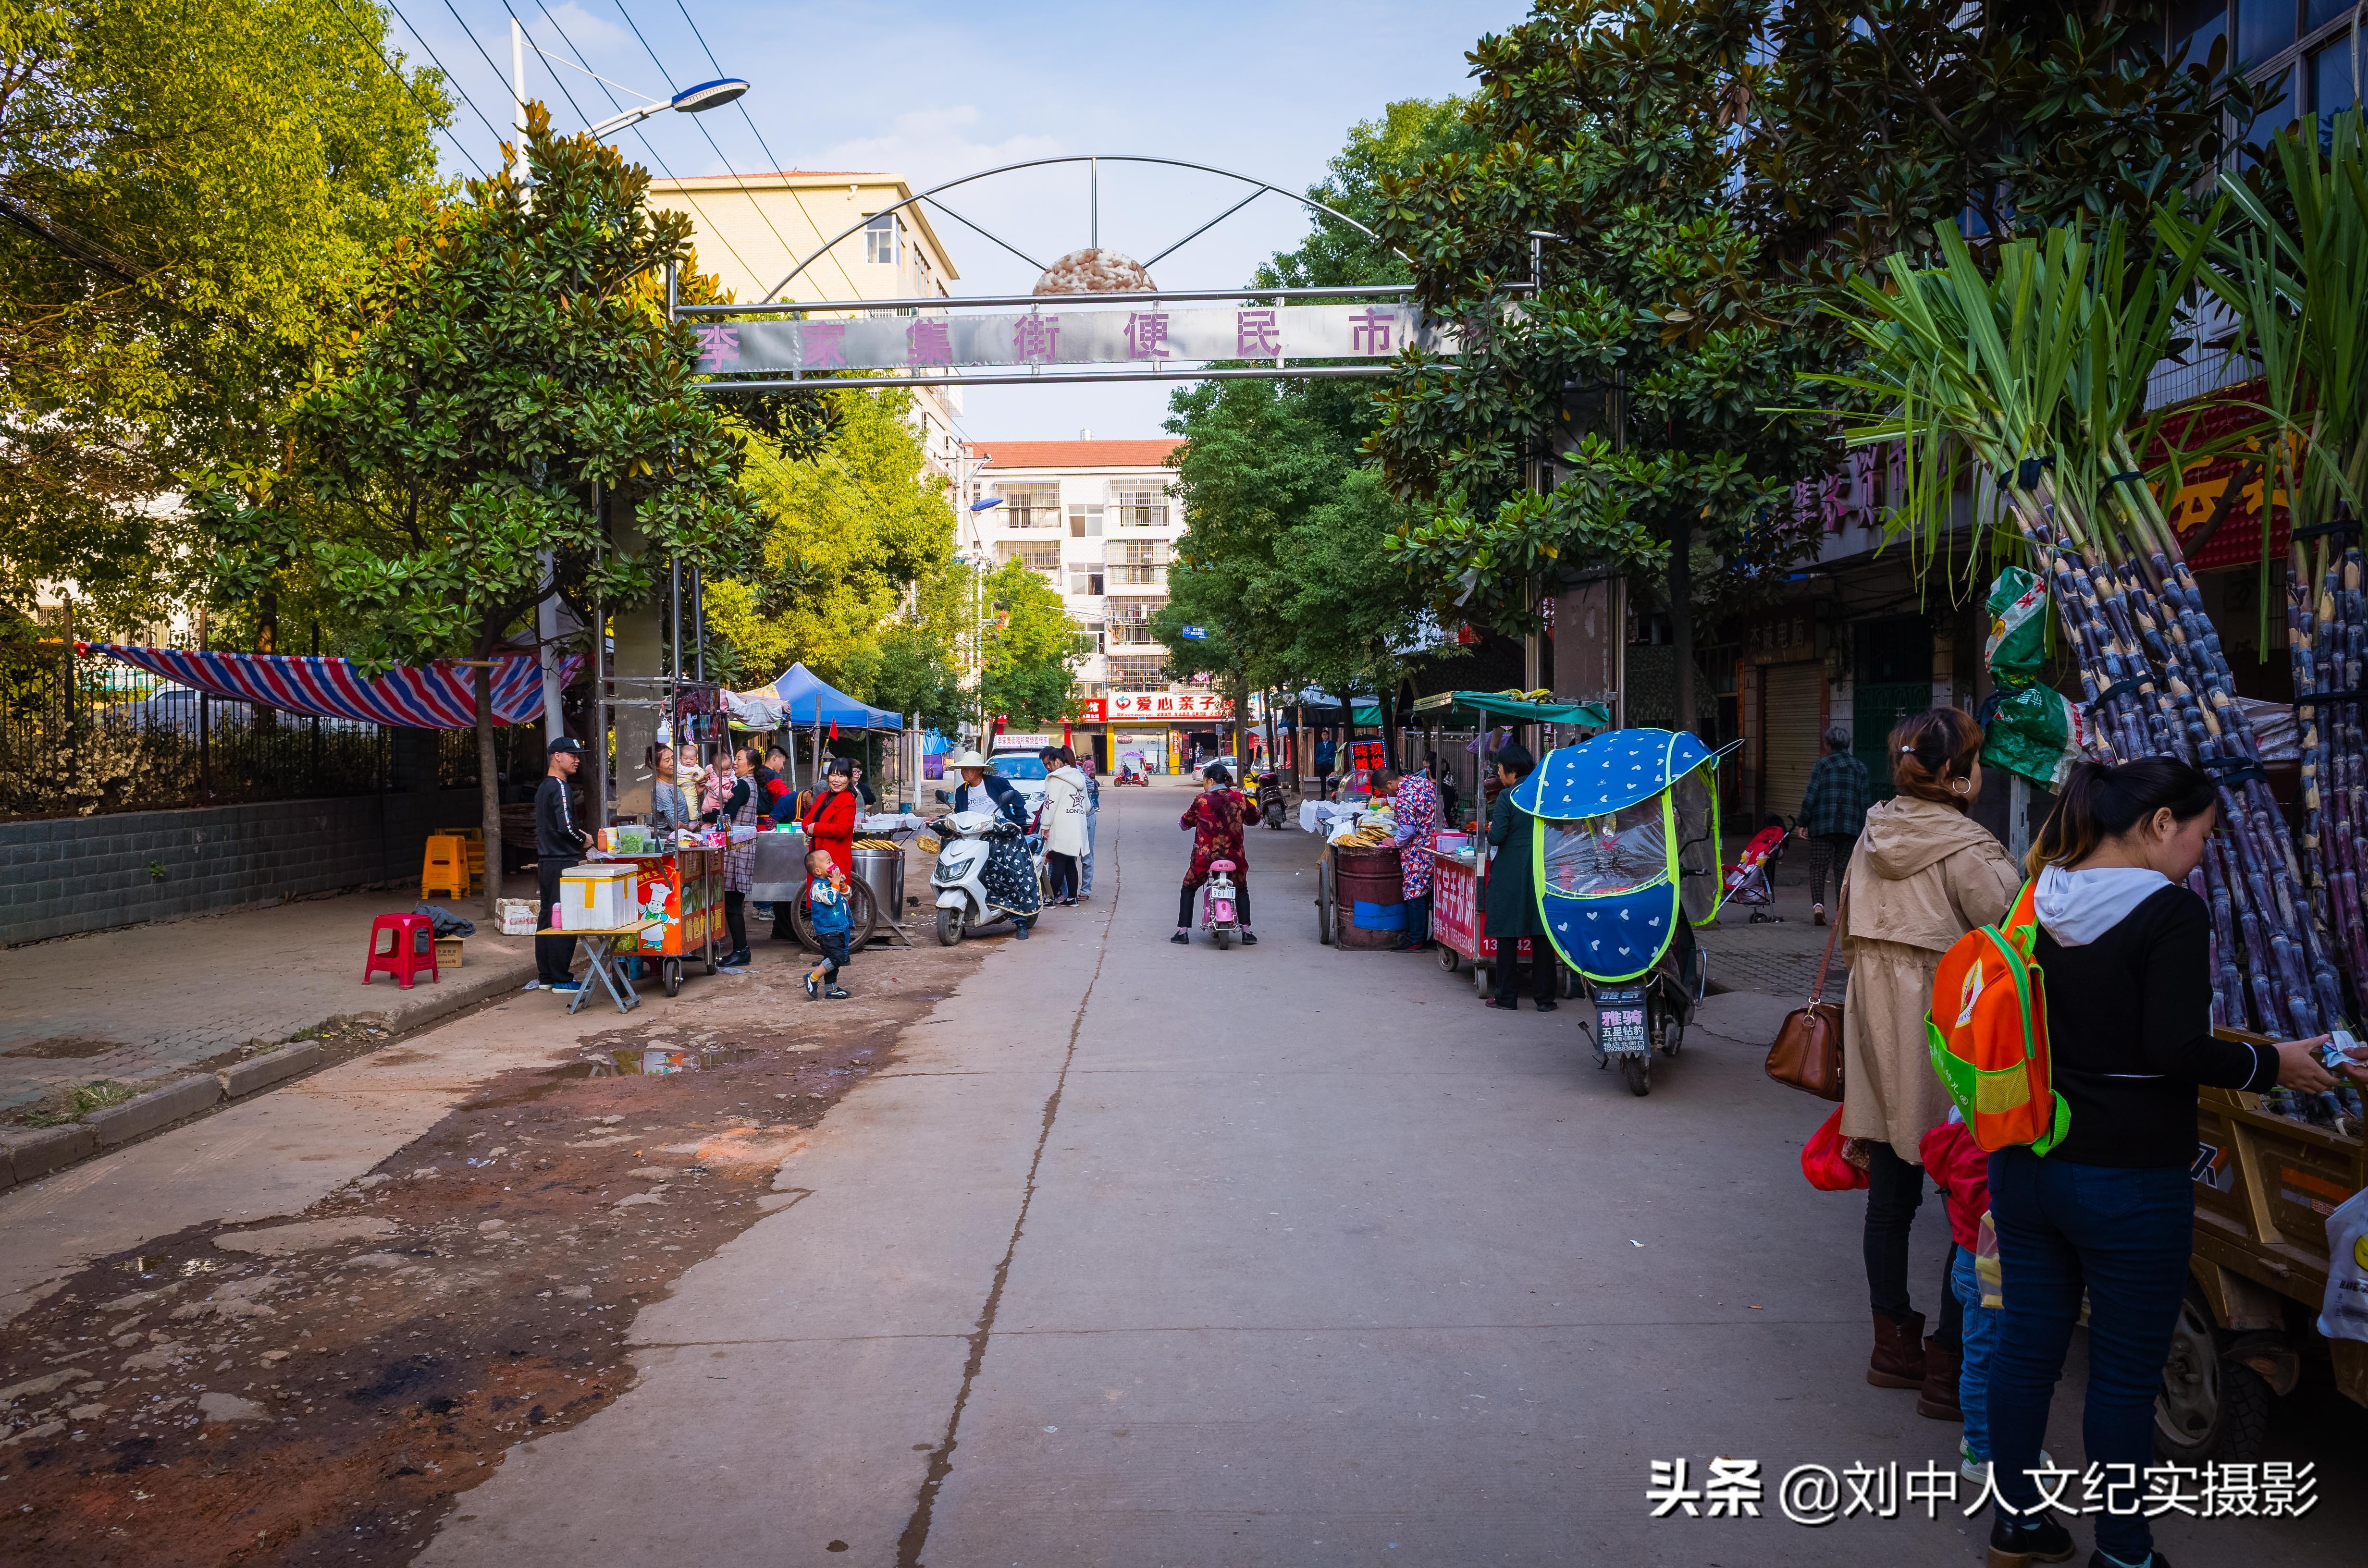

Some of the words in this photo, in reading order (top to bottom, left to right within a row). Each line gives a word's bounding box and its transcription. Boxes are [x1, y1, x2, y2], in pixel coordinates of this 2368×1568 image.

[696, 306, 1490, 371] 李家集街便民市
[1750, 615, 1804, 652] 杰诚电脑
[998, 736, 1048, 745] 李家集街秸秆禁烧宣传车
[1602, 1010, 1643, 1027] 雅骑
[1602, 1025, 1644, 1037] 五星钻豹
[2339, 1280, 2360, 1292] HAVE
